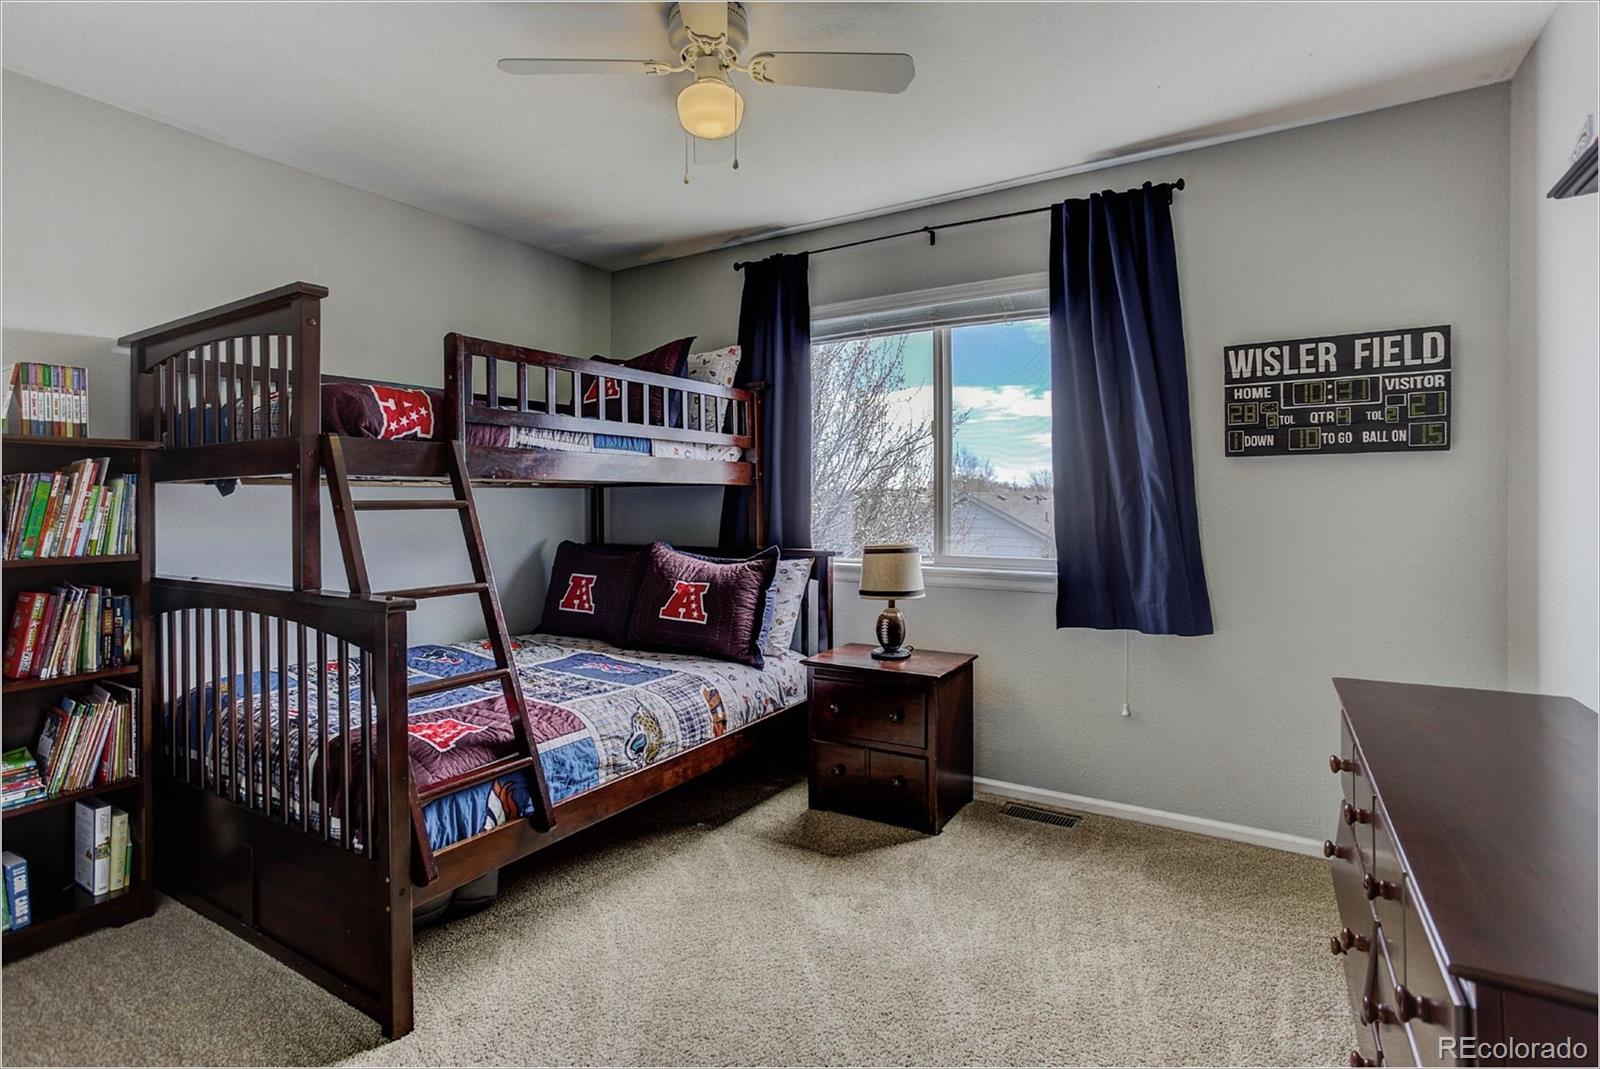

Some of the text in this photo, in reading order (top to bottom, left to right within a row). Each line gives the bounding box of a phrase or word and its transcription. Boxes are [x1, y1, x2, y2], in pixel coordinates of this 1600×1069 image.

[1228, 331, 1445, 379] WISLER FIELD
[1385, 375, 1445, 390] VISITOR
[1234, 386, 1272, 400] HOME
[1411, 392, 1444, 415] 21
[1279, 415, 1296, 425] TOL
[1310, 410, 1335, 424] QTR
[1365, 410, 1384, 421] TOL
[1244, 434, 1275, 447] DOWN
[1298, 430, 1353, 448] 10 TO GO
[1362, 424, 1443, 444] BALL ON 15
[559, 573, 597, 615] A
[659, 580, 710, 625] A
